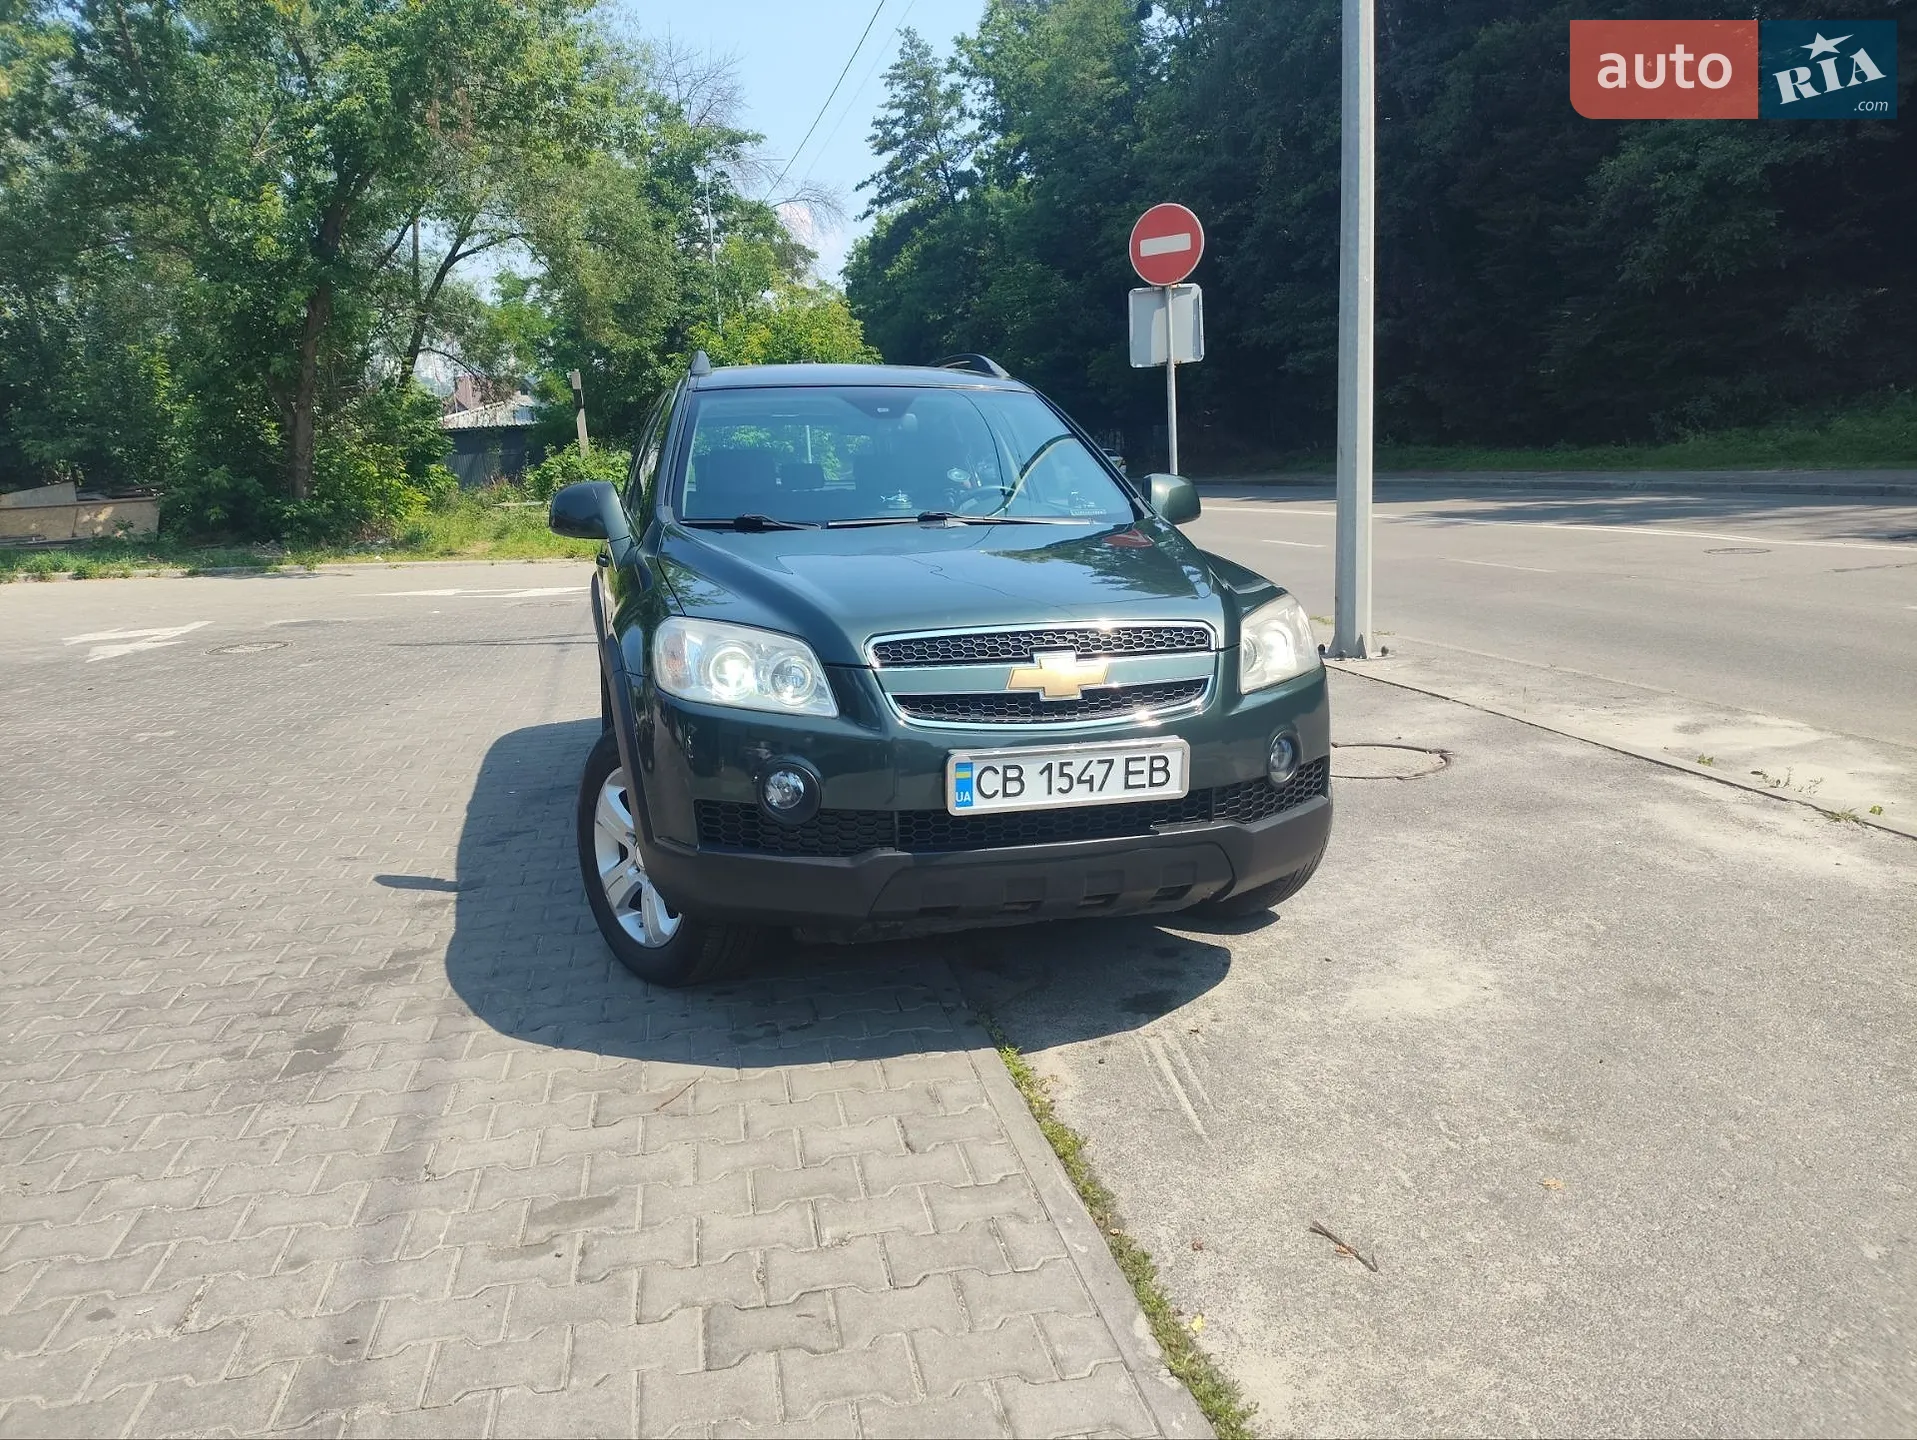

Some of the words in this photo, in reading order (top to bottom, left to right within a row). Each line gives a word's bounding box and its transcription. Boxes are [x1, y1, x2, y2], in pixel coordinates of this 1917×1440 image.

[976, 764, 1025, 799] CB
[1038, 758, 1115, 796] 1547
[1124, 754, 1171, 790] EB
[956, 791, 972, 803] UA
